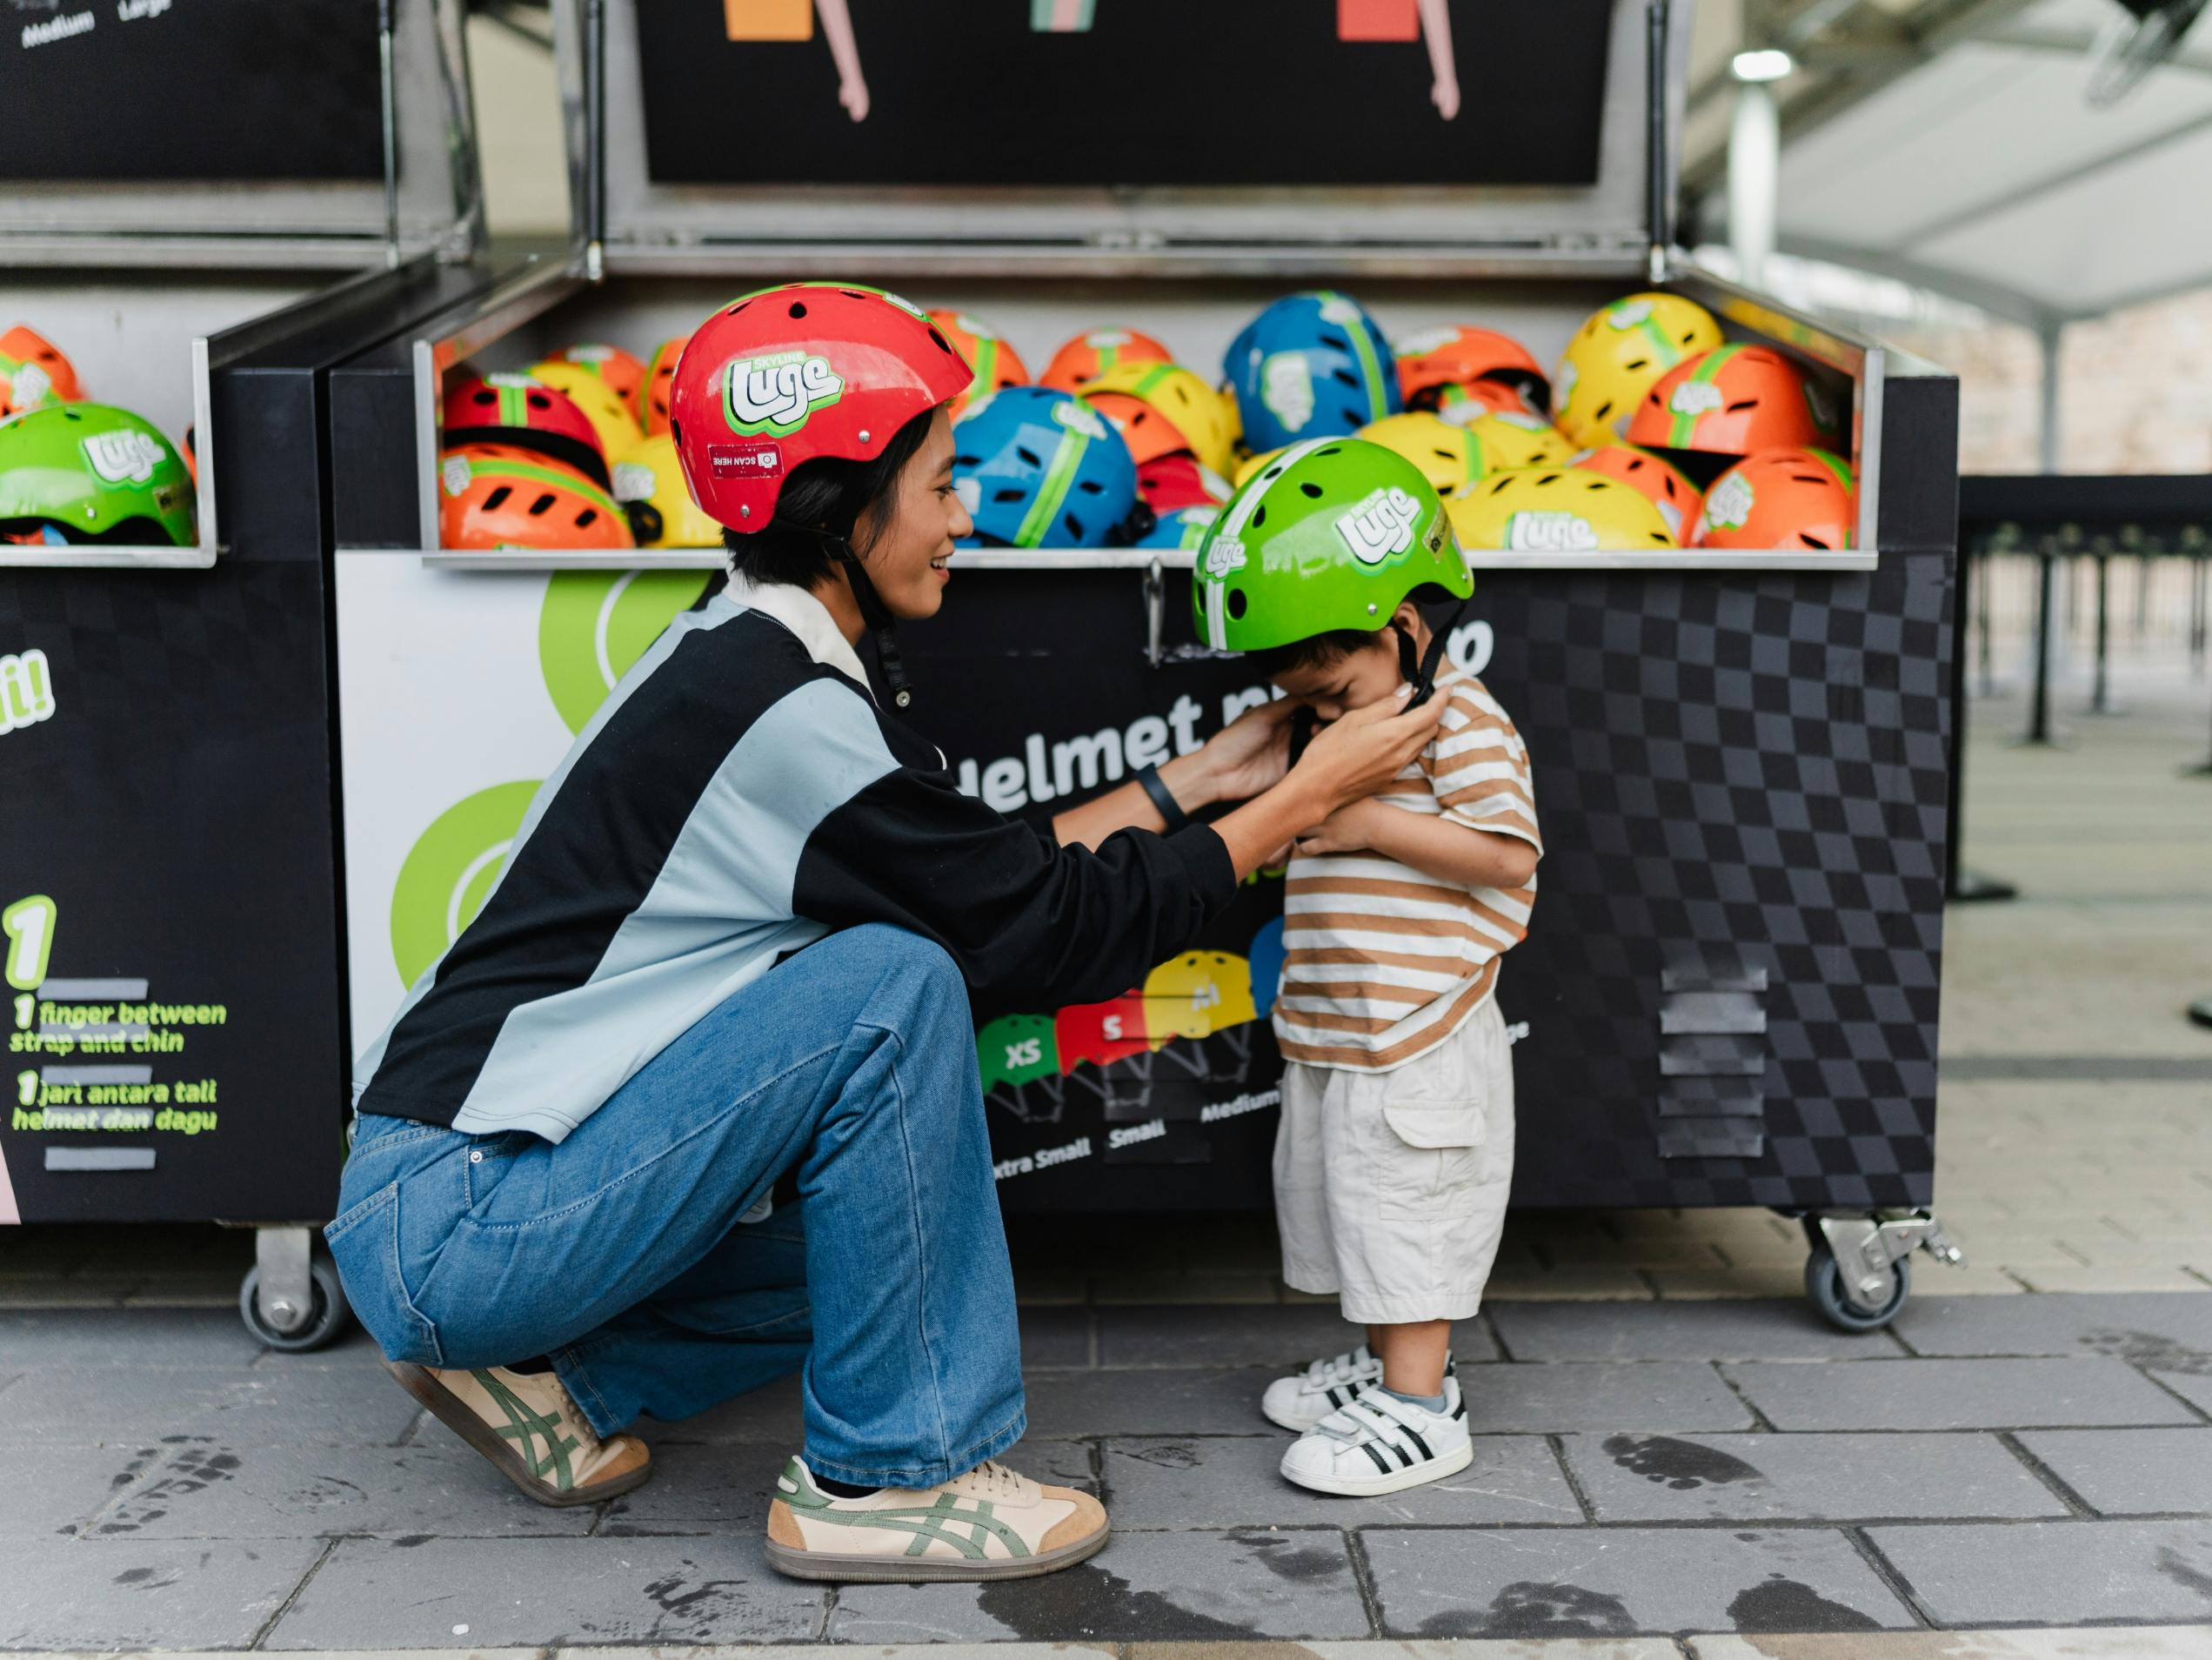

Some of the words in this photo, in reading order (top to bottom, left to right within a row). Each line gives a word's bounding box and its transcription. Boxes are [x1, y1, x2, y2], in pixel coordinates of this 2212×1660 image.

[22, 10, 95, 49] Medium
[754, 351, 805, 370] SKYLINE
[730, 358, 842, 425] Luge
[713, 457, 732, 465] HERE
[733, 456, 756, 465] SCAN
[1335, 487, 1421, 566] Luge
[3, 894, 57, 990] 1
[14, 993, 35, 1029] 1
[39, 1001, 115, 1029] finger
[118, 1001, 227, 1025] between
[1102, 1014, 1122, 1040] S
[10, 1029, 75, 1056] strap
[79, 1030, 126, 1053] and
[130, 1028, 184, 1052] chin
[1006, 1038, 1041, 1069] XS
[17, 1069, 38, 1106] 1
[38, 1079, 83, 1107] jari
[87, 1082, 170, 1104] antara
[175, 1079, 217, 1102] tali
[12, 1106, 99, 1131] helmet
[101, 1108, 150, 1131] dan
[155, 1107, 217, 1135] dagu
[1200, 1089, 1280, 1122] Medium
[1109, 1119, 1166, 1148] Small
[993, 1157, 1033, 1181] xtra
[1035, 1138, 1092, 1169] Small
